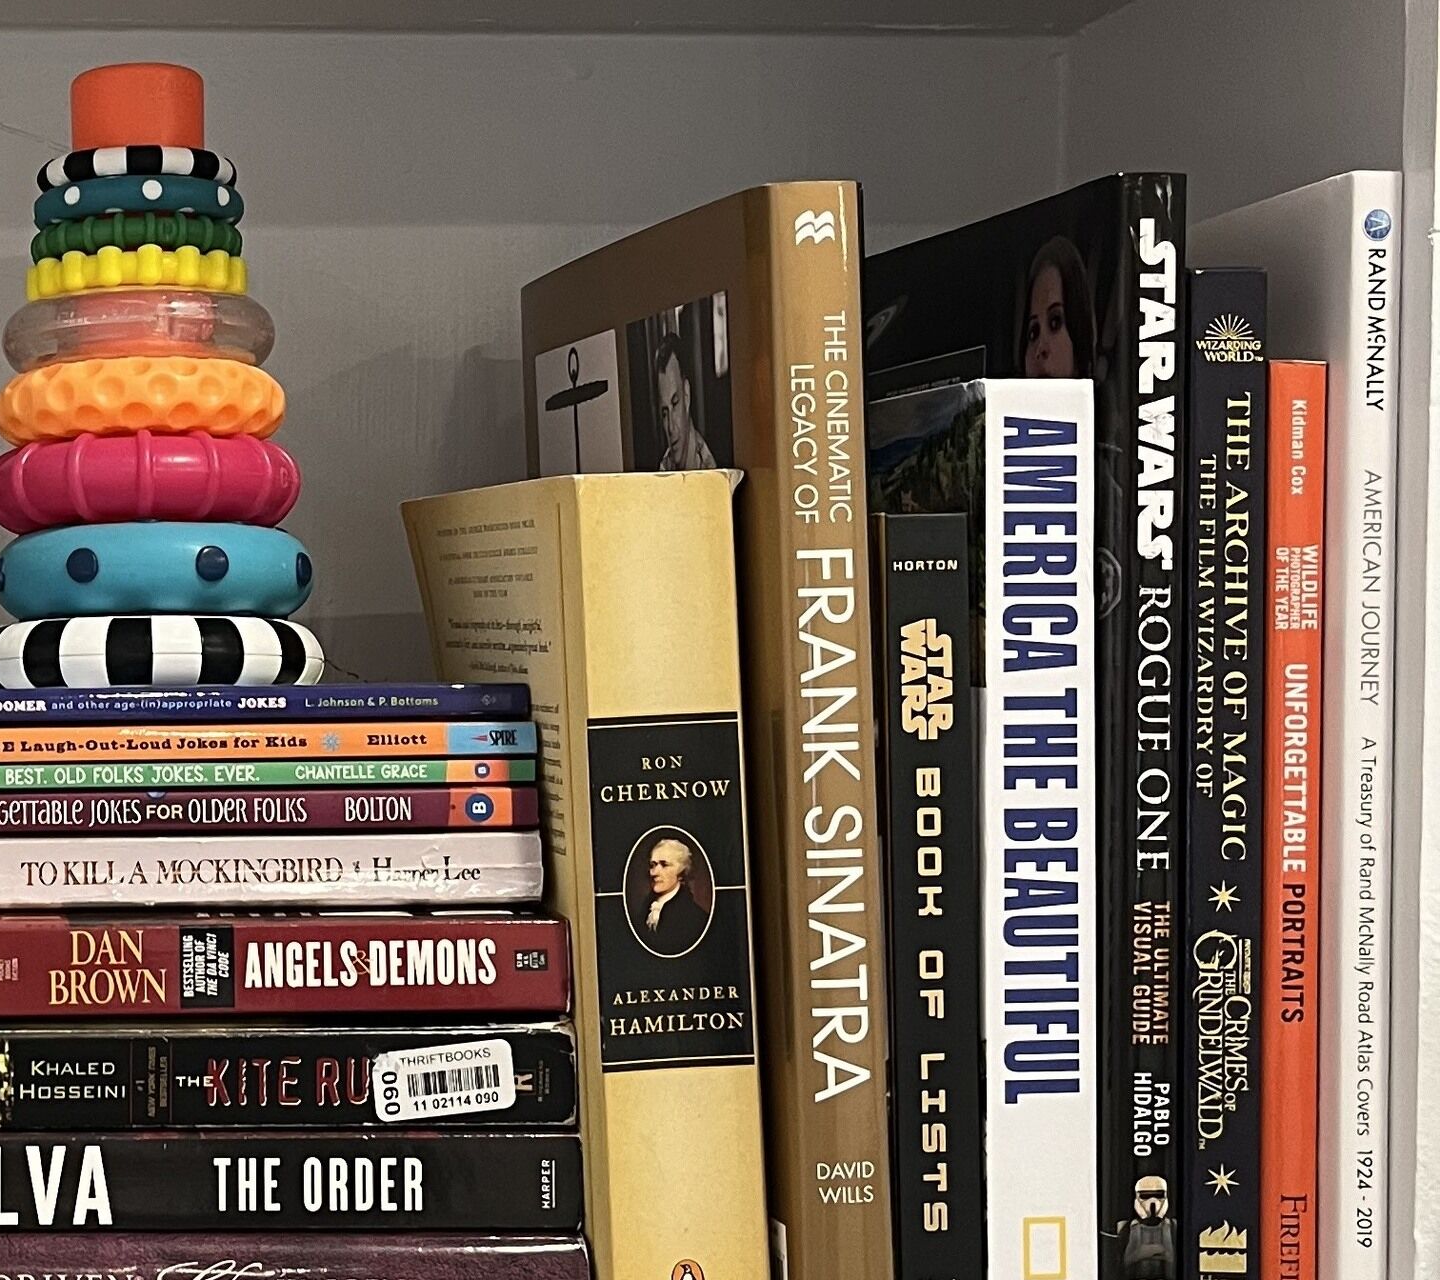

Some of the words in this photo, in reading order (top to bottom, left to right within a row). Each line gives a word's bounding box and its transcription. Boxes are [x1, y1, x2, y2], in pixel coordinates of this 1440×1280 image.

[1138, 217, 1177, 393] STAR
[1367, 248, 1386, 312] RAND
[823, 310, 848, 362] THE
[790, 363, 818, 477] LEGACY
[1226, 391, 1252, 471] THE
[1290, 399, 1308, 460] Kidman
[824, 369, 853, 524] CINEMATIC
[793, 483, 820, 524] OF
[1137, 395, 1176, 571] WARS
[1290, 465, 1308, 496] Cox
[1002, 415, 1079, 673] AMERICA
[1361, 469, 1383, 593] AMERICAN
[892, 558, 959, 572] HORTON
[1223, 480, 1251, 661] ARCHIVE
[795, 546, 859, 784] FRANK
[1136, 584, 1172, 752] ROGUE
[1359, 602, 1381, 707] JOURNEY
[51, 699, 74, 711] and
[77, 698, 111, 711] other
[237, 696, 288, 710] JOKES
[1222, 670, 1249, 721] OF
[20, 738, 172, 755] Laugh-Out-Loud
[176, 737, 229, 751] Jokes
[233, 736, 260, 749] for
[265, 735, 308, 749] Kids
[366, 733, 428, 747] Elliott
[641, 755, 684, 771] RON
[1002, 686, 1079, 790] THE
[1361, 736, 1377, 750] A
[5, 768, 48, 786] BEST.
[54, 767, 87, 784] OLD
[92, 766, 144, 784] FOLKS
[151, 765, 208, 783] JOKES.
[600, 779, 731, 803] CHERNOW
[1282, 662, 1308, 873] UNFORGETTABLE
[1355, 756, 1377, 829] Treasury
[1136, 767, 1172, 872] ONE
[1220, 731, 1248, 862] MAGIC
[1359, 833, 1377, 851] of
[20, 860, 58, 886] TO
[62, 859, 125, 886] KILL
[128, 859, 148, 885] A
[156, 856, 345, 885] MOCKINGBIRD
[1359, 857, 1376, 900] Rand
[69, 929, 145, 968] DAN
[244, 940, 359, 989] ANGELS
[368, 936, 497, 987] DEMONS
[804, 804, 872, 1103] SINATRA
[1002, 806, 1081, 1105] BEAUTIFUL
[1280, 883, 1306, 1023] PORTRAITS
[1354, 907, 1375, 976] McNally
[47, 968, 168, 1008] BROWN
[612, 985, 740, 1006] ALEXANDER
[1357, 981, 1375, 1024] Road
[609, 1011, 746, 1036] HAMILTON
[30, 1060, 116, 1077] KHALED
[399, 1046, 492, 1070] THRIFTBOOKS
[1357, 1030, 1374, 1072] Atlas
[19, 1084, 127, 1101] HOSSEINI
[412, 1097, 427, 1112] 11
[432, 1095, 472, 1111] 02114
[475, 1091, 500, 1106] 090
[1356, 1078, 1374, 1137] Covers
[212, 1156, 282, 1212] THE
[302, 1156, 424, 1212] ORDER
